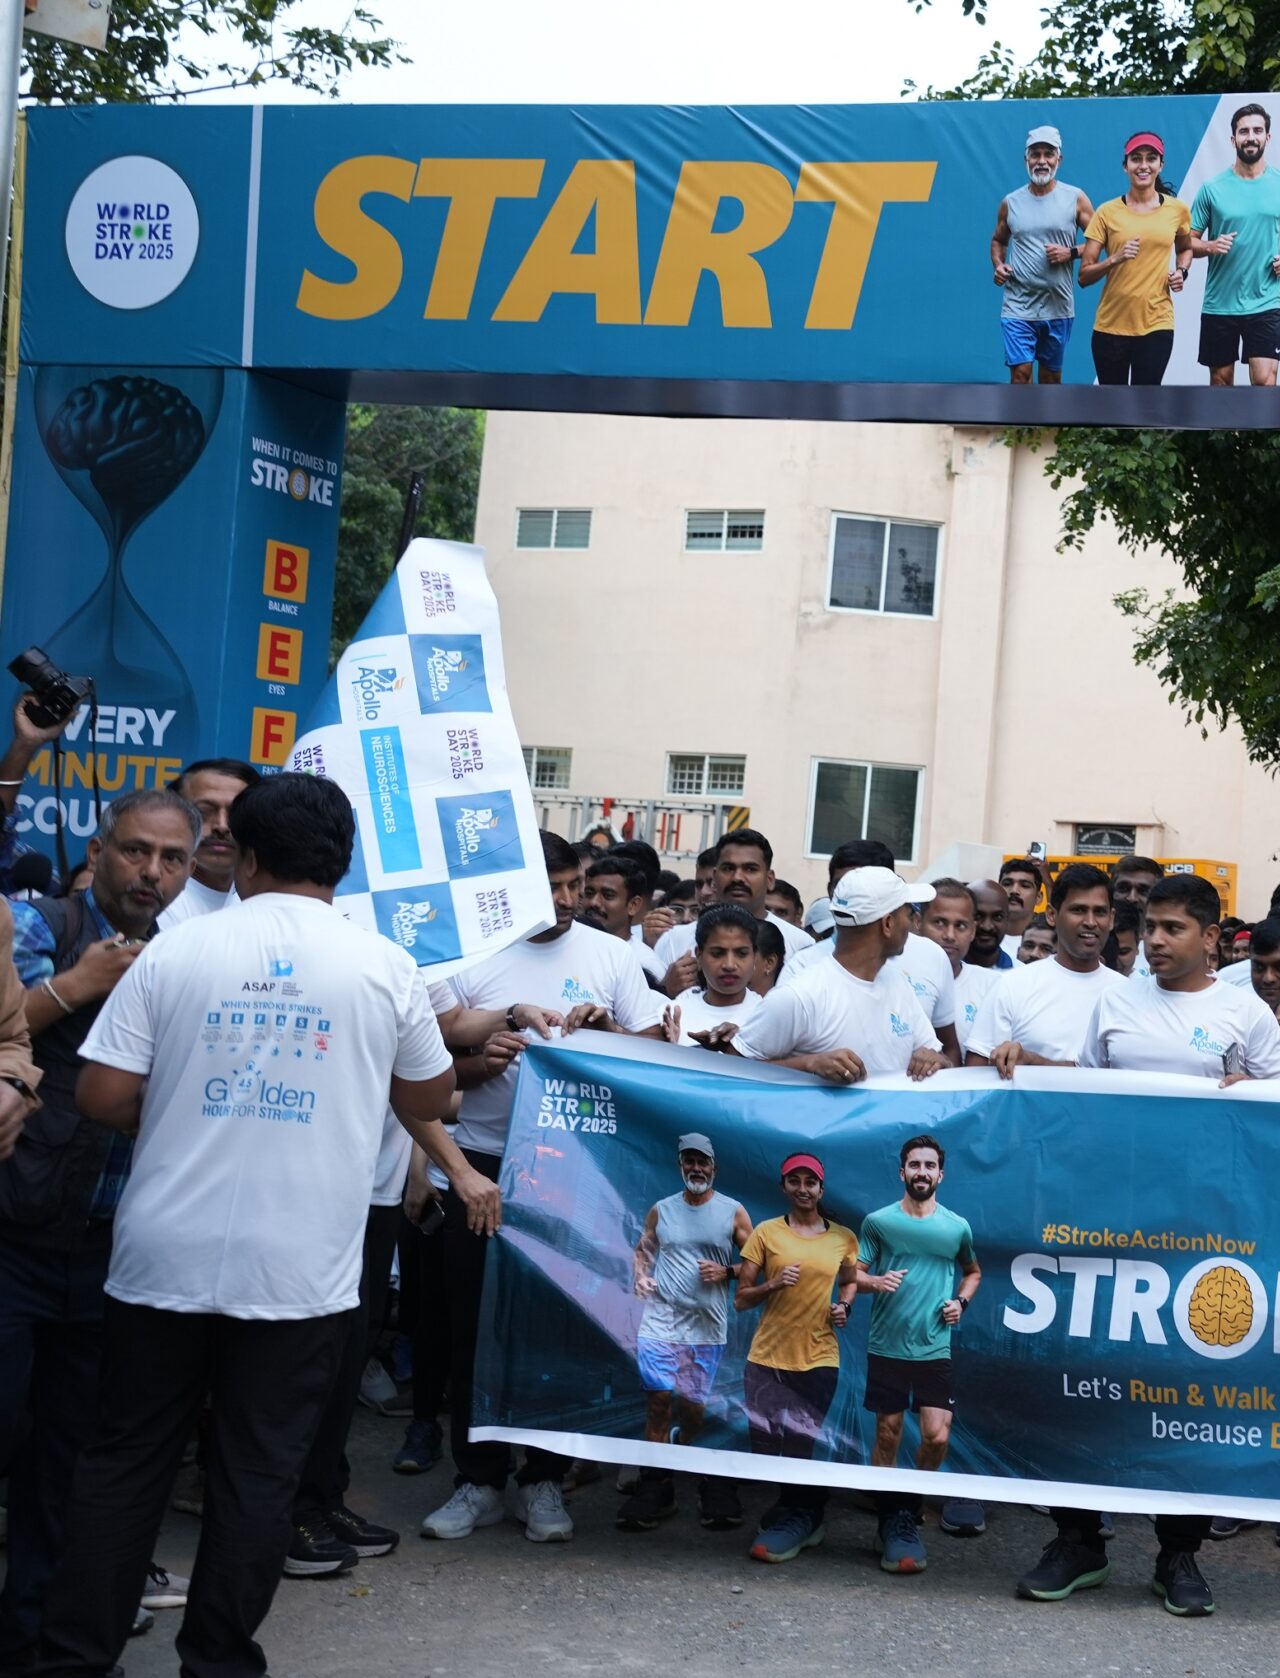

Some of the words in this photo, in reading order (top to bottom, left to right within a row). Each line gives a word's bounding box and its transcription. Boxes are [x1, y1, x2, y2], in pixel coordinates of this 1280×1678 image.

[97, 203, 170, 220] WORLD
[96, 223, 172, 240] STROKE
[296, 155, 938, 329] START
[95, 242, 134, 260] DAY
[138, 243, 174, 260] 2025
[252, 436, 280, 459] WHEN
[282, 446, 292, 461] IT
[293, 450, 325, 472] COMES
[326, 459, 338, 476] TO
[251, 458, 334, 507] STROKE
[273, 547, 298, 594] B
[420, 571, 432, 599] DAY
[268, 600, 298, 616] BALANCE
[424, 595, 437, 618] 2025
[268, 631, 291, 677] E
[426, 658, 440, 702] HOSPITALS
[428, 647, 450, 692] Apollo
[268, 684, 286, 695] EYES
[351, 667, 381, 721] Apollo
[65, 704, 177, 747] VERY
[262, 714, 285, 758] F
[447, 729, 459, 759] DAY
[383, 735, 398, 781] INSTITUTES
[392, 783, 400, 795] OF
[450, 756, 464, 780] 2025
[371, 736, 396, 834] NEUROSCIENCES
[15, 794, 110, 837] COU
[456, 808, 479, 853] Apollo
[1165, 864, 1194, 874] JCB
[475, 892, 488, 917] DAY
[392, 901, 416, 948] Apollo
[479, 916, 492, 939] 2025
[242, 981, 276, 992] ASAP
[561, 989, 594, 1001] Apollo
[221, 1000, 250, 1009] WHEN
[253, 1001, 286, 1011] STROKE
[289, 1004, 322, 1015] STRIKES
[1189, 1037, 1223, 1051] Apollo
[545, 1078, 612, 1101] WORLD
[231, 1105, 256, 1117] FOR
[259, 1106, 313, 1124] STROKE
[540, 1095, 616, 1118] STROKE
[537, 1111, 581, 1132] DAY
[581, 1117, 617, 1135] 2025
[1041, 1224, 1256, 1256] #StrokeActionNow
[1063, 1373, 1122, 1401] Let's
[1130, 1379, 1178, 1404] Run
[1186, 1384, 1205, 1407] &
[1213, 1384, 1276, 1411] Walk
[1152, 1412, 1262, 1449] because
